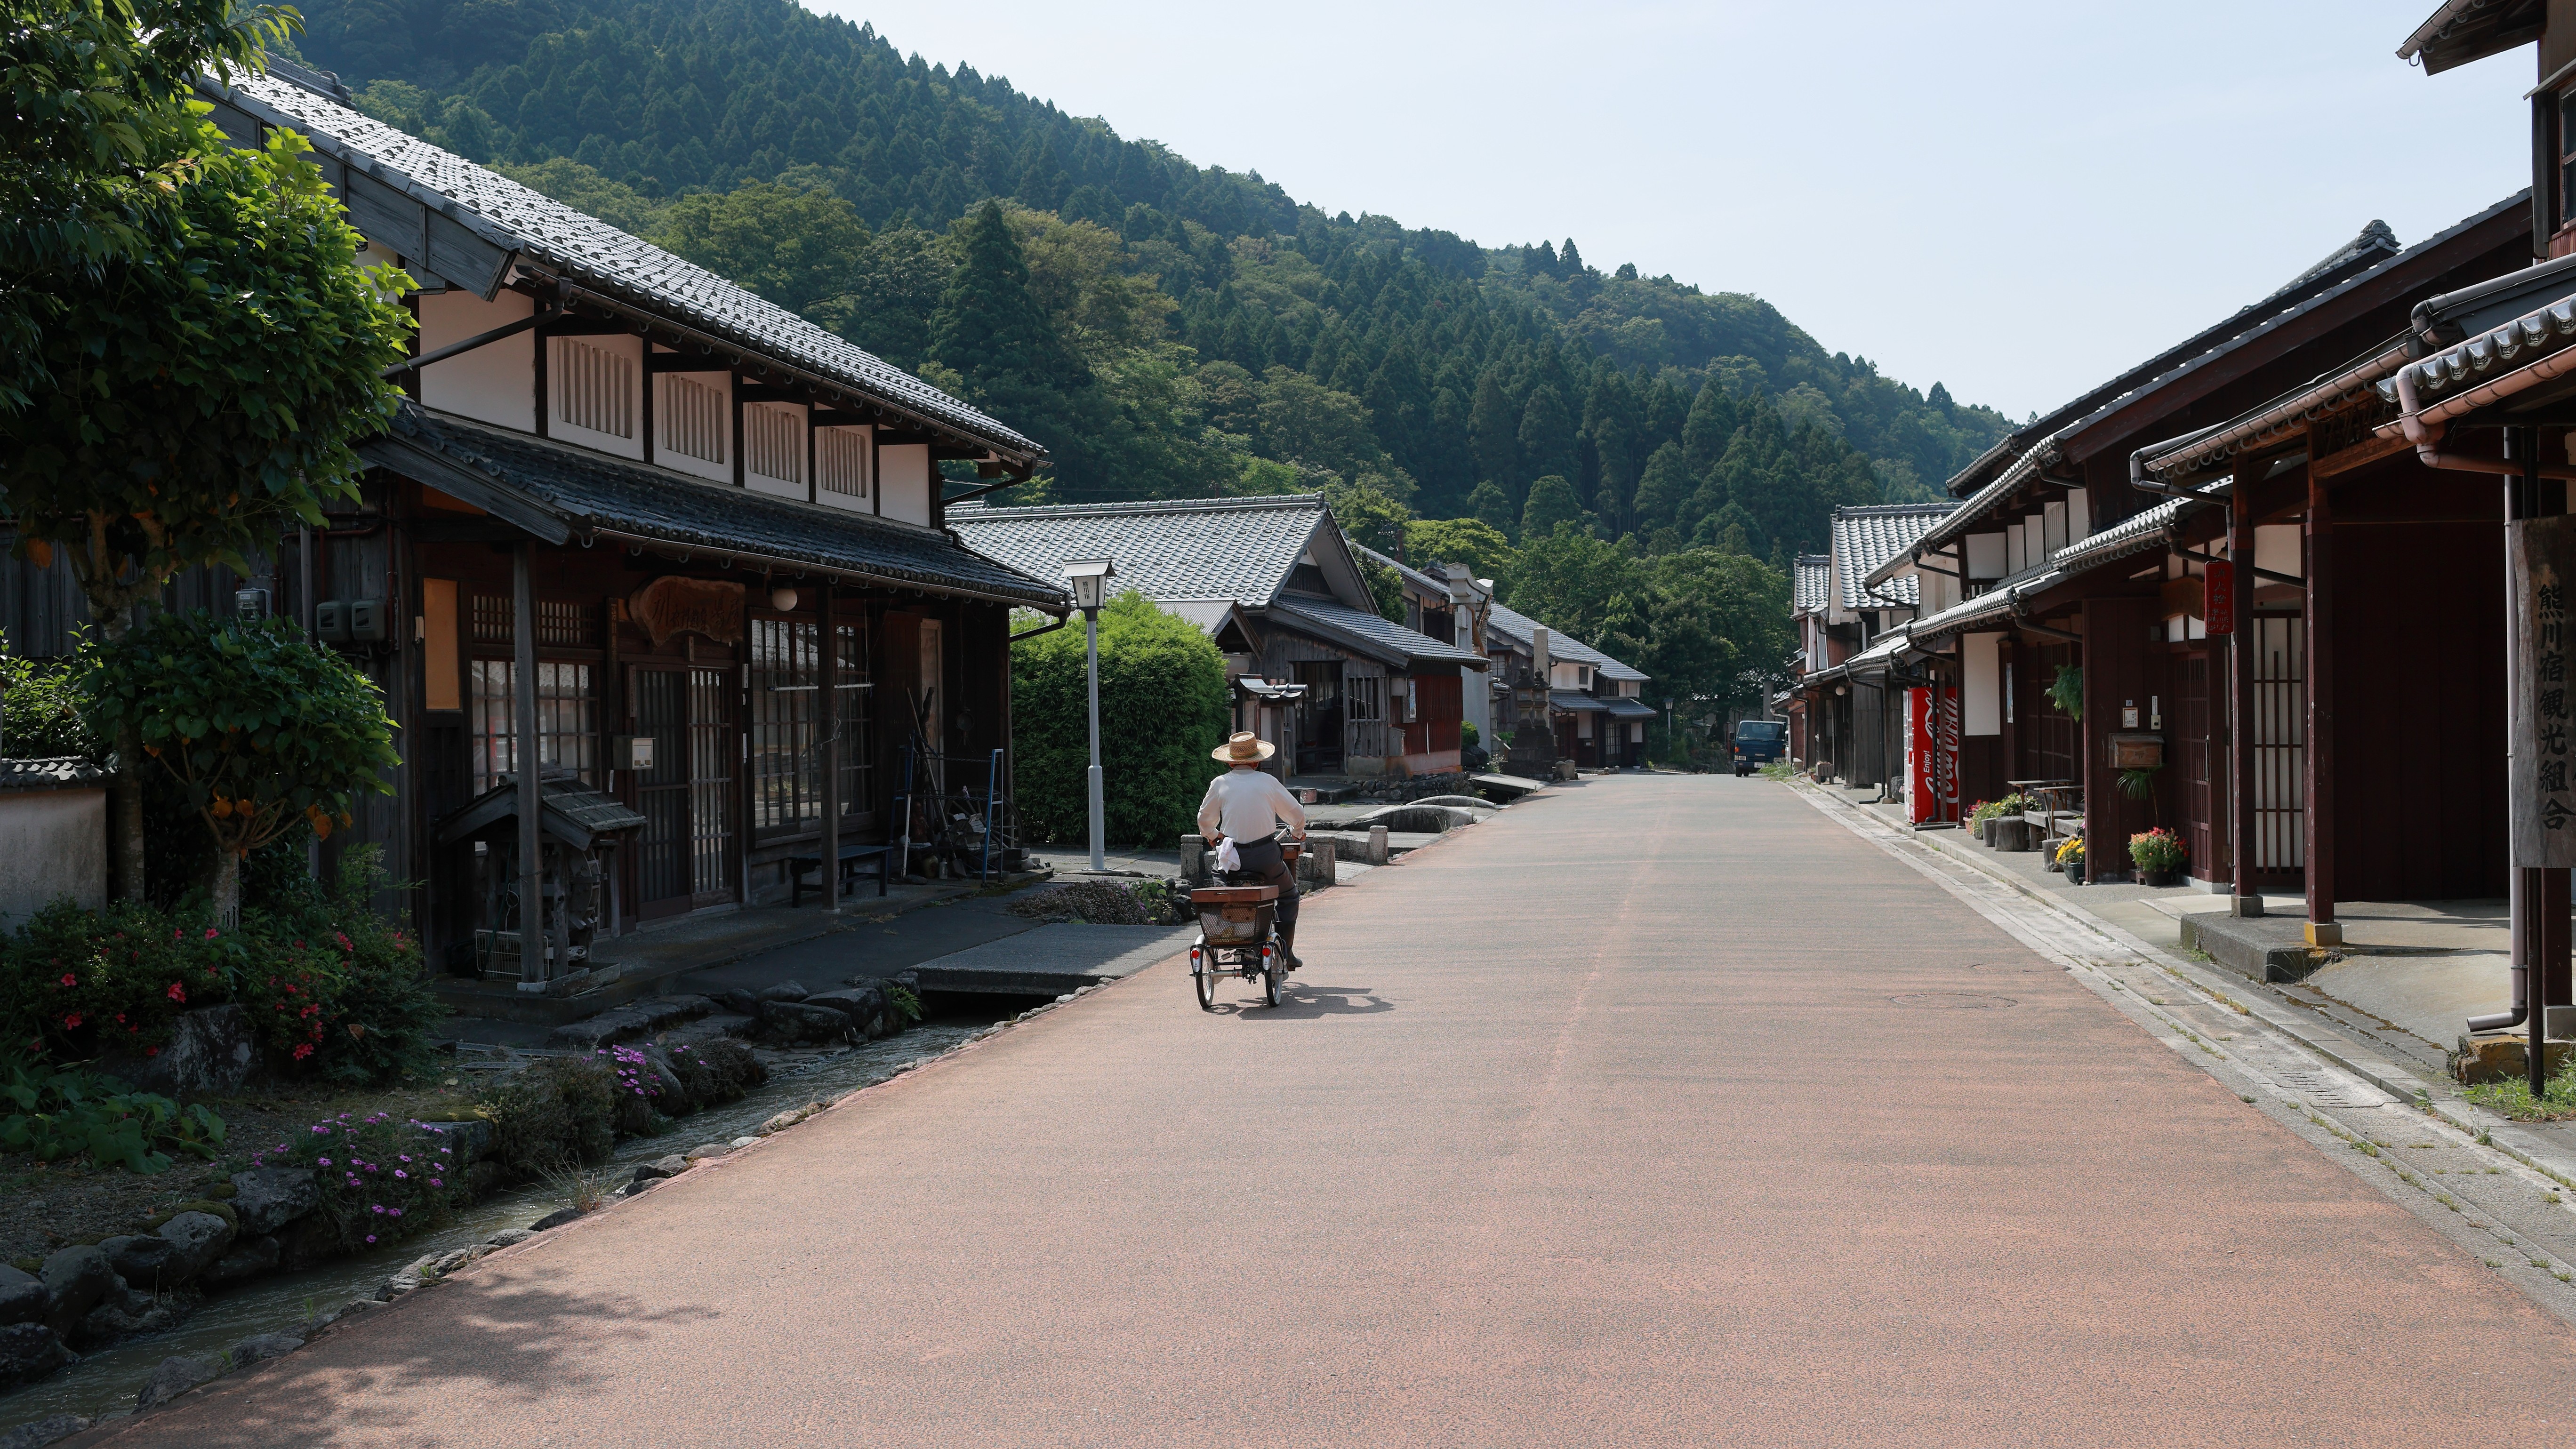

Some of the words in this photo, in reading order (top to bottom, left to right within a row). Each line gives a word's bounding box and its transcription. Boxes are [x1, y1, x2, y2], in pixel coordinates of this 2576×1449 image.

[1923, 750, 1931, 773] Enjoy!
[2539, 584, 2576, 830] 熊川宿観光組合
